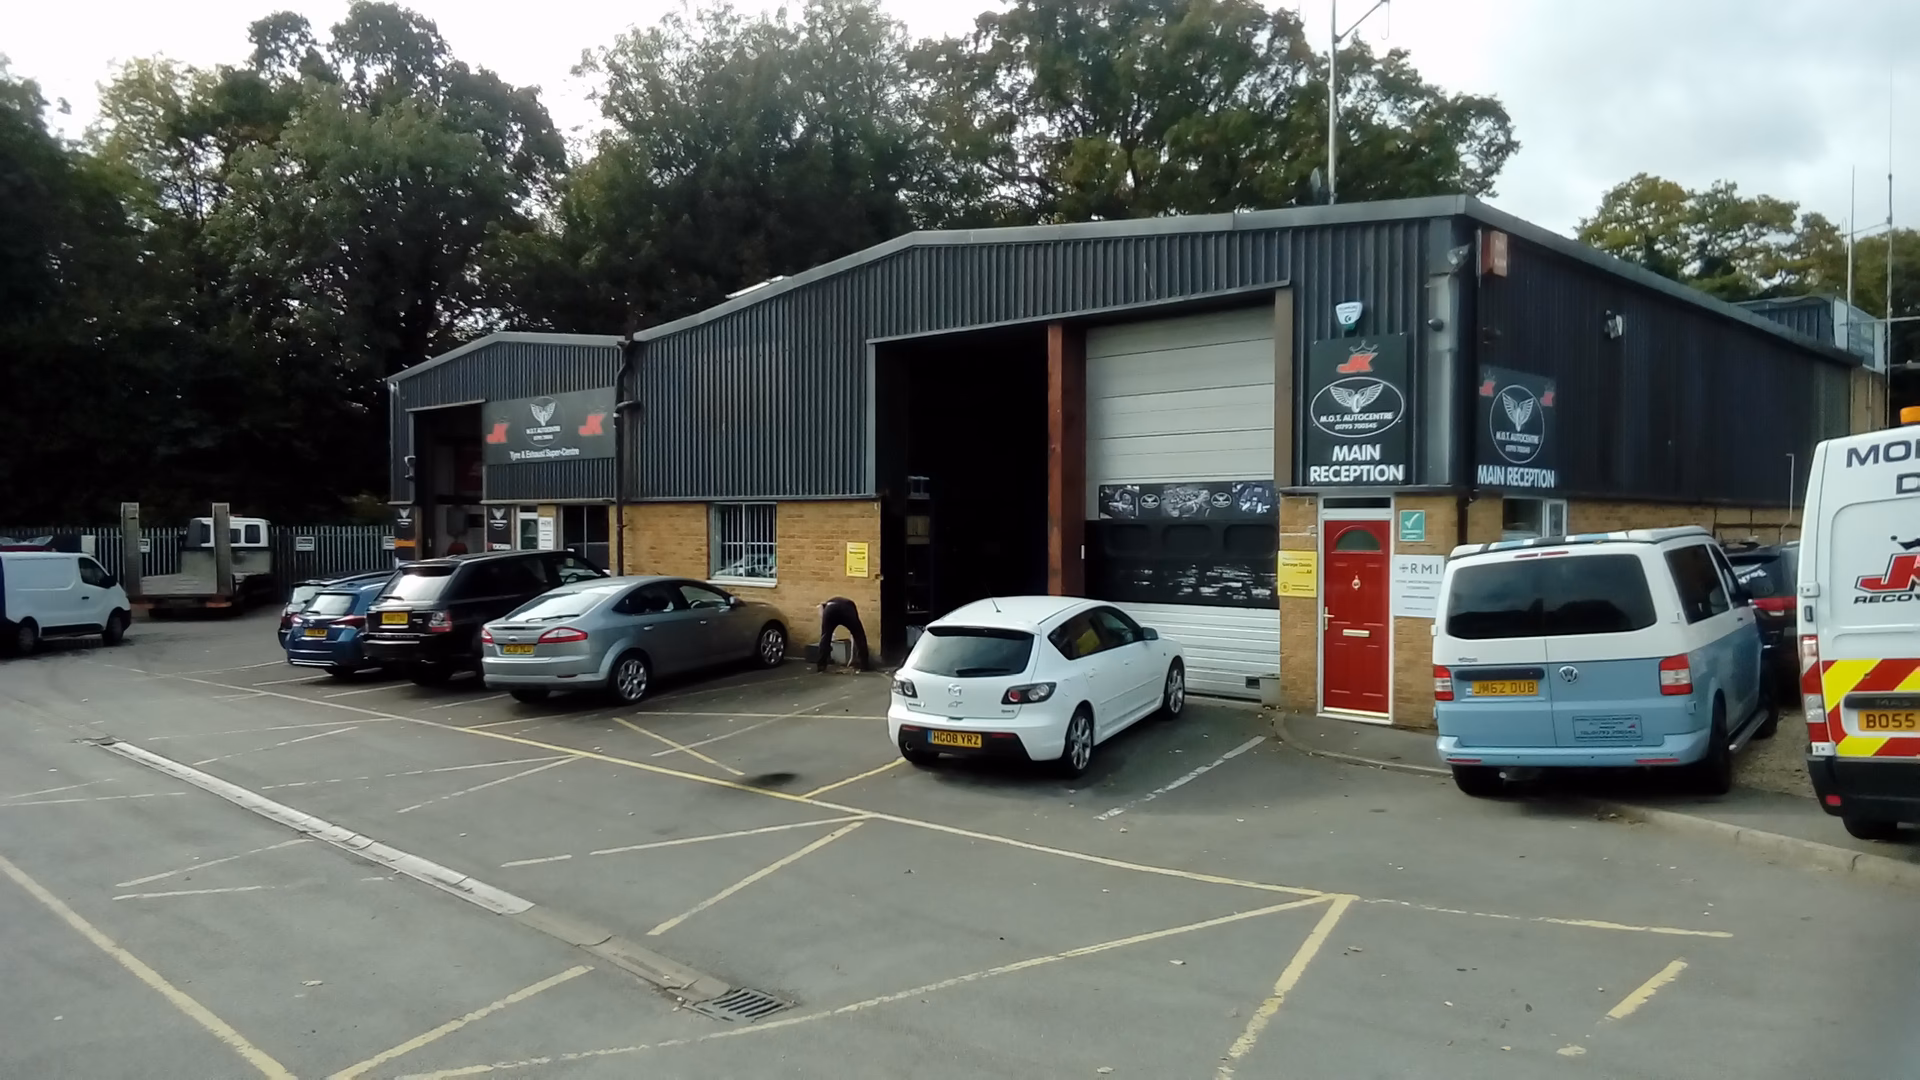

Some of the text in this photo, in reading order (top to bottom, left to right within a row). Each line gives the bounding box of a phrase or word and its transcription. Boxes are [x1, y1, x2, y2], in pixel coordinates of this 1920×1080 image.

[1319, 411, 1394, 424] M.O.T. AUTOCENTRE
[1332, 443, 1382, 462] MAIN
[1846, 438, 1920, 468] MO
[1309, 464, 1406, 482] RECEPTION
[1477, 464, 1555, 488] MAIN RECEPTION
[1854, 552, 1920, 594] J
[1510, 681, 1536, 693] DUB
[1866, 713, 1916, 729] BO55
[932, 731, 980, 746] HG08 YRZ
